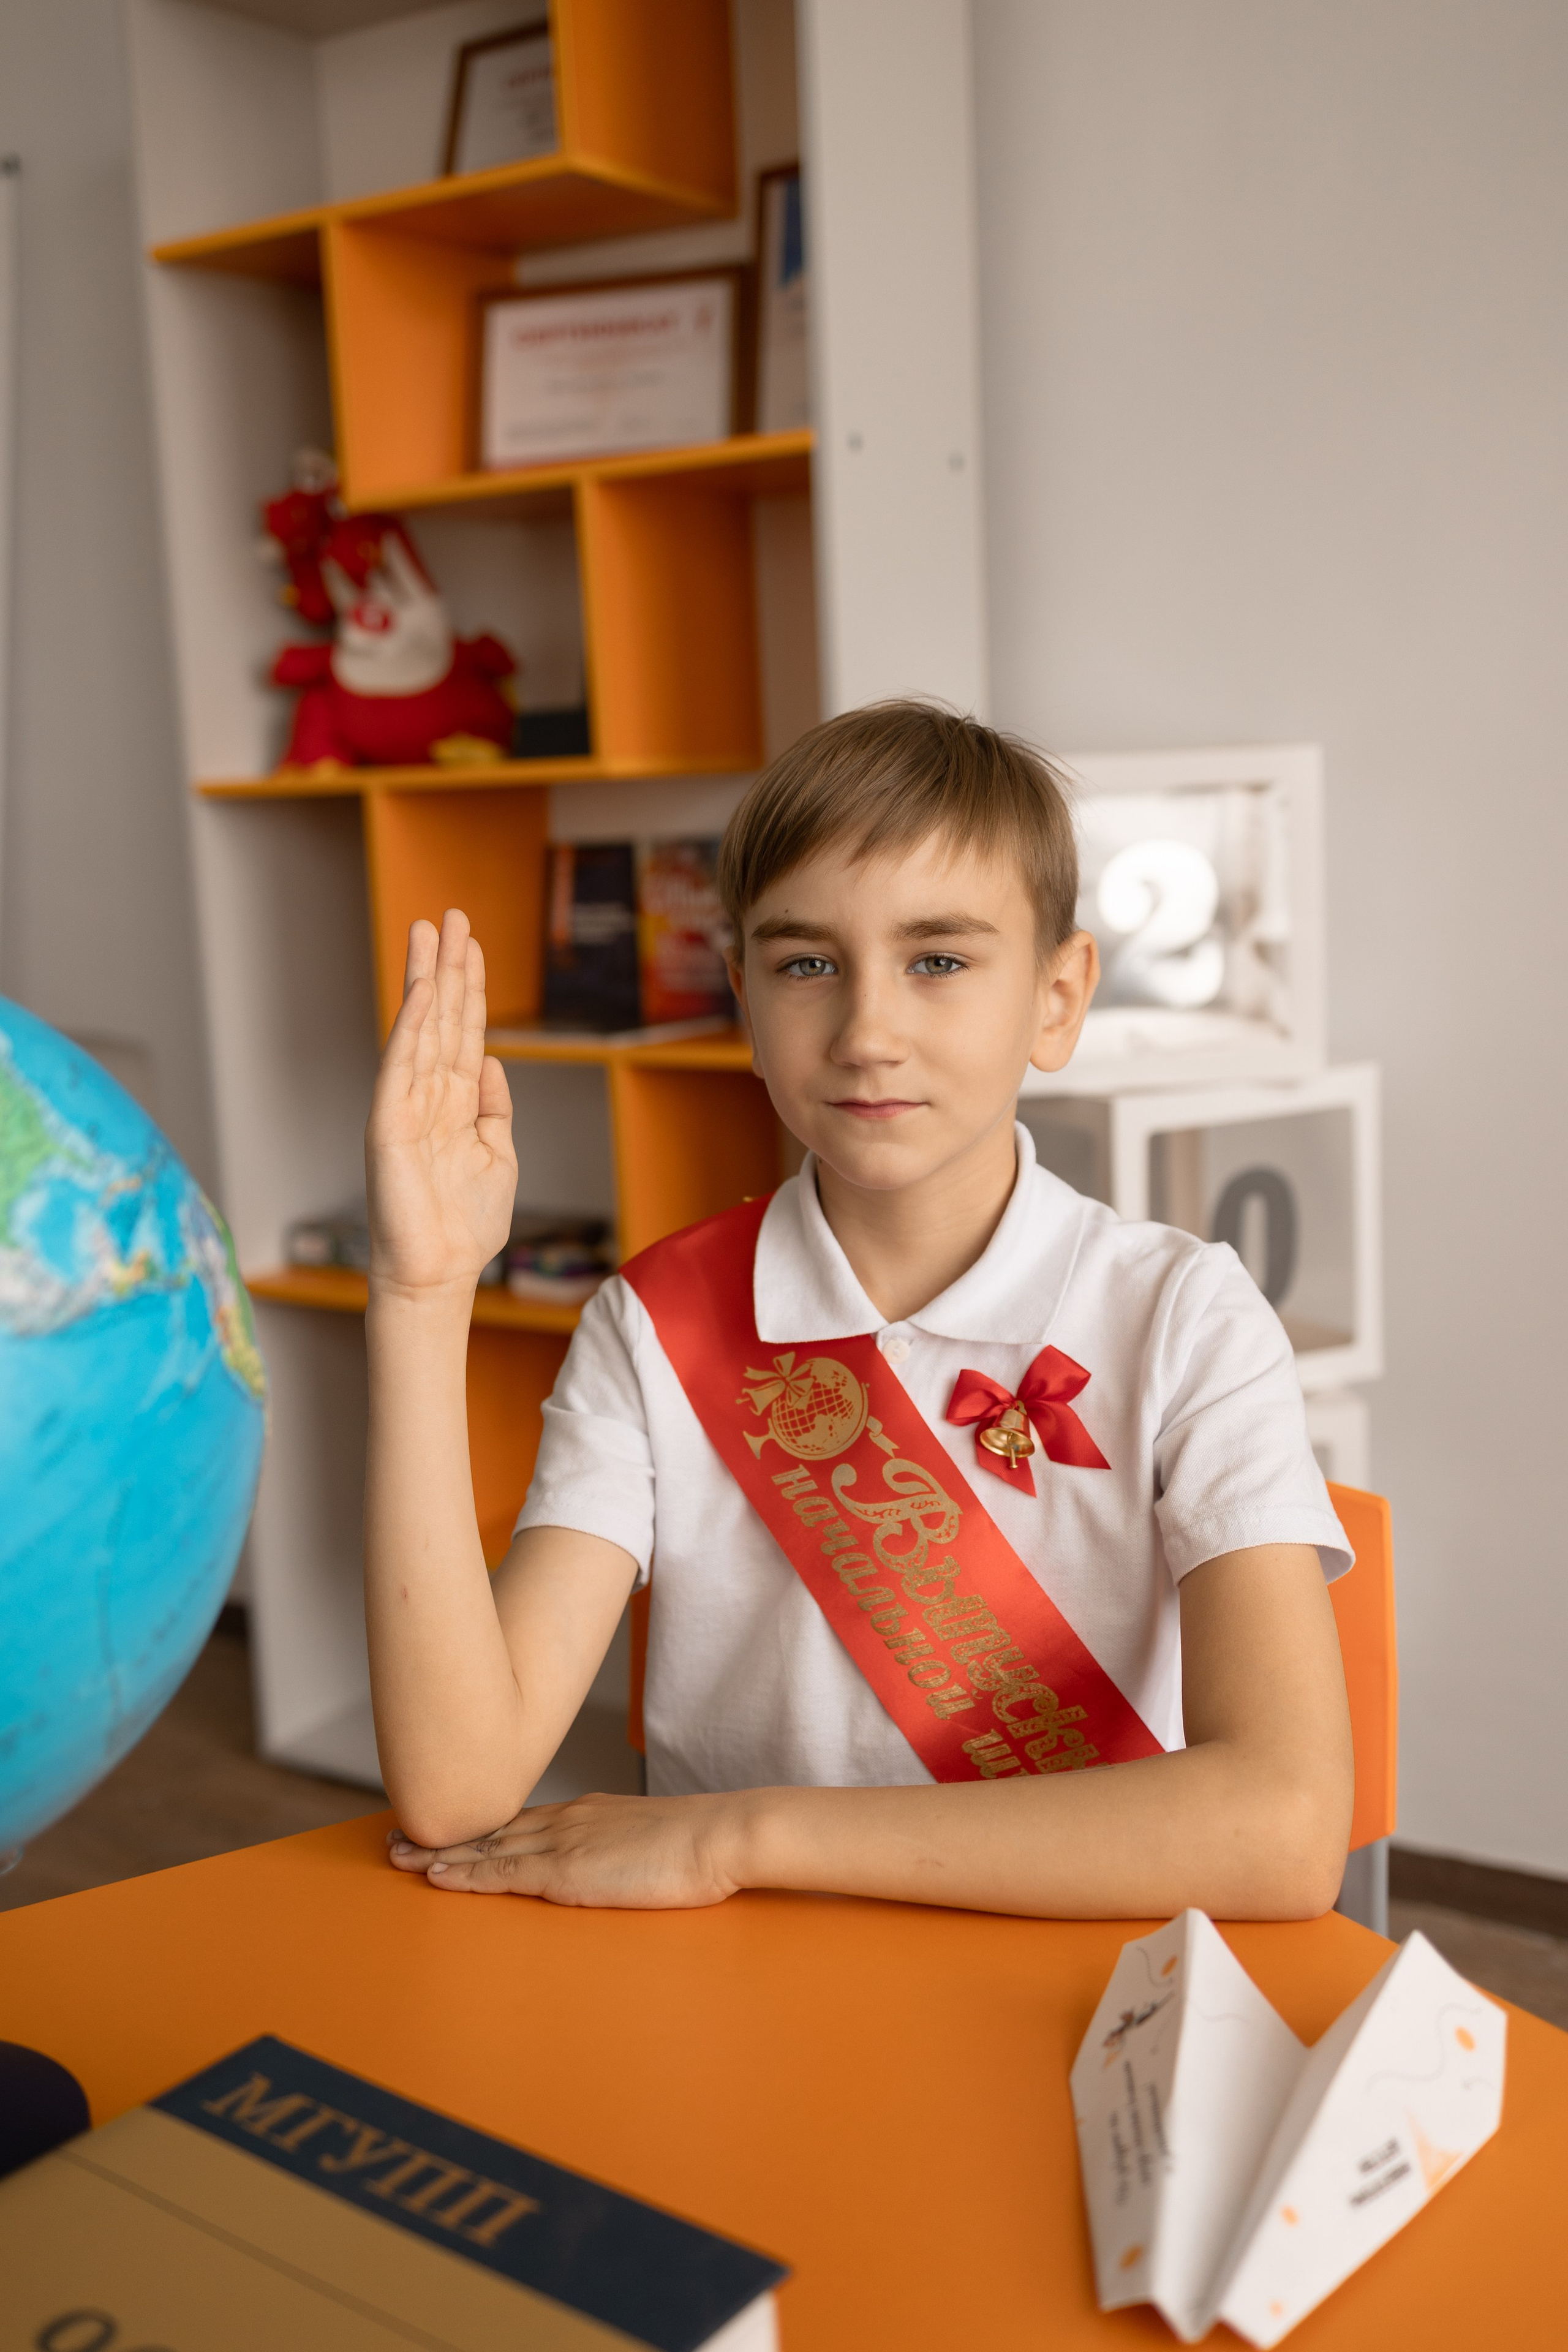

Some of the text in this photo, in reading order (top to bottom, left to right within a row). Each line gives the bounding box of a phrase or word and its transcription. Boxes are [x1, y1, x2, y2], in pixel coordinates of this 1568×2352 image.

[1098, 839, 1224, 1009] 2
[1212, 1165, 1299, 1310] 0
[771, 1464, 1031, 1779] начальной ш
[201, 2071, 540, 2249] МГУПП
